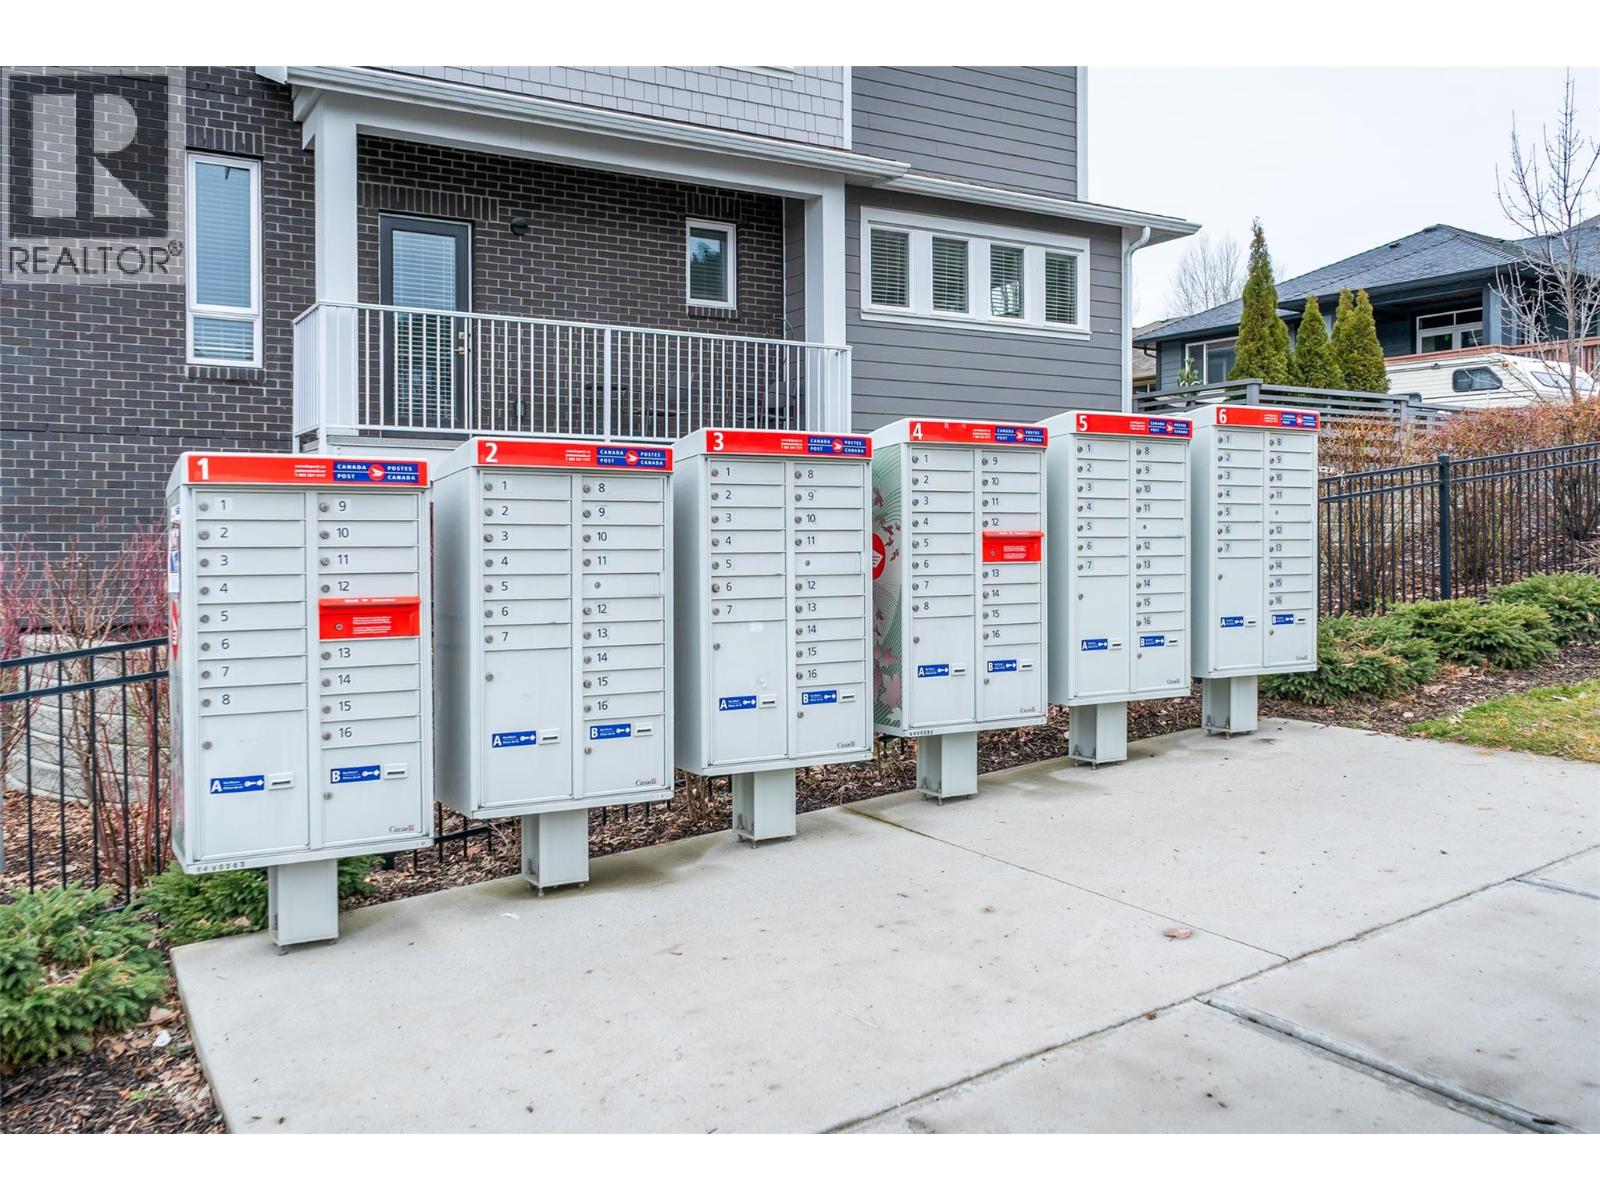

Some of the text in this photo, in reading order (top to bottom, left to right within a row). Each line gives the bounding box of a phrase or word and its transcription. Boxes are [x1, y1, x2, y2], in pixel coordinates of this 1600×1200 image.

[1219, 409, 1227, 423] 6
[1079, 415, 1087, 431] 5
[913, 423, 923, 439] 4
[713, 433, 724, 450] 3
[485, 443, 498, 463] 2
[197, 458, 209, 480] 1
[807, 469, 814, 478] 8
[598, 483, 606, 492] 8
[725, 490, 732, 499] 2
[807, 490, 816, 500] 9
[338, 501, 347, 512] 9
[501, 506, 509, 515] 2
[598, 507, 606, 517] 9
[725, 513, 732, 522] 3
[806, 514, 816, 523] 10
[219, 527, 229, 539] 2
[336, 528, 350, 539] 10
[501, 531, 509, 541] 3
[597, 532, 608, 541] 10
[725, 535, 732, 544] 4
[807, 535, 815, 544] 11
[220, 555, 229, 567] 3
[337, 555, 349, 565] 11
[500, 556, 509, 565] 4
[597, 556, 607, 565] 11
[725, 559, 732, 568] 5
[219, 583, 229, 593] 4
[337, 581, 350, 592] 12
[501, 581, 509, 591] 5
[725, 582, 733, 591] 6
[807, 580, 816, 589] 12
[597, 604, 607, 613] 12
[726, 605, 733, 614] 7
[806, 601, 817, 611] 13
[220, 611, 229, 622] 5
[501, 607, 509, 616] 6
[1221, 618, 1226, 626] A
[1272, 616, 1276, 624] B
[597, 628, 608, 638] 13
[807, 624, 817, 633] 14
[501, 632, 509, 641] 7
[221, 639, 230, 650] 6
[1082, 641, 1087, 651] A
[1140, 638, 1144, 646] B
[338, 648, 351, 658] 13
[807, 647, 817, 656] 15
[597, 653, 608, 662] 14
[988, 661, 993, 671] B
[221, 667, 230, 677] 7
[807, 669, 818, 678] 16
[918, 667, 925, 676] A
[337, 674, 351, 685] 14
[597, 677, 609, 686] 15
[221, 694, 231, 706] 8
[803, 694, 808, 703] B
[338, 701, 352, 712] 15
[597, 701, 609, 710] 16
[720, 700, 727, 709] A
[338, 727, 353, 738] 16
[592, 727, 598, 738] B
[493, 736, 502, 746] A
[332, 770, 340, 782] B
[211, 780, 222, 792] A
